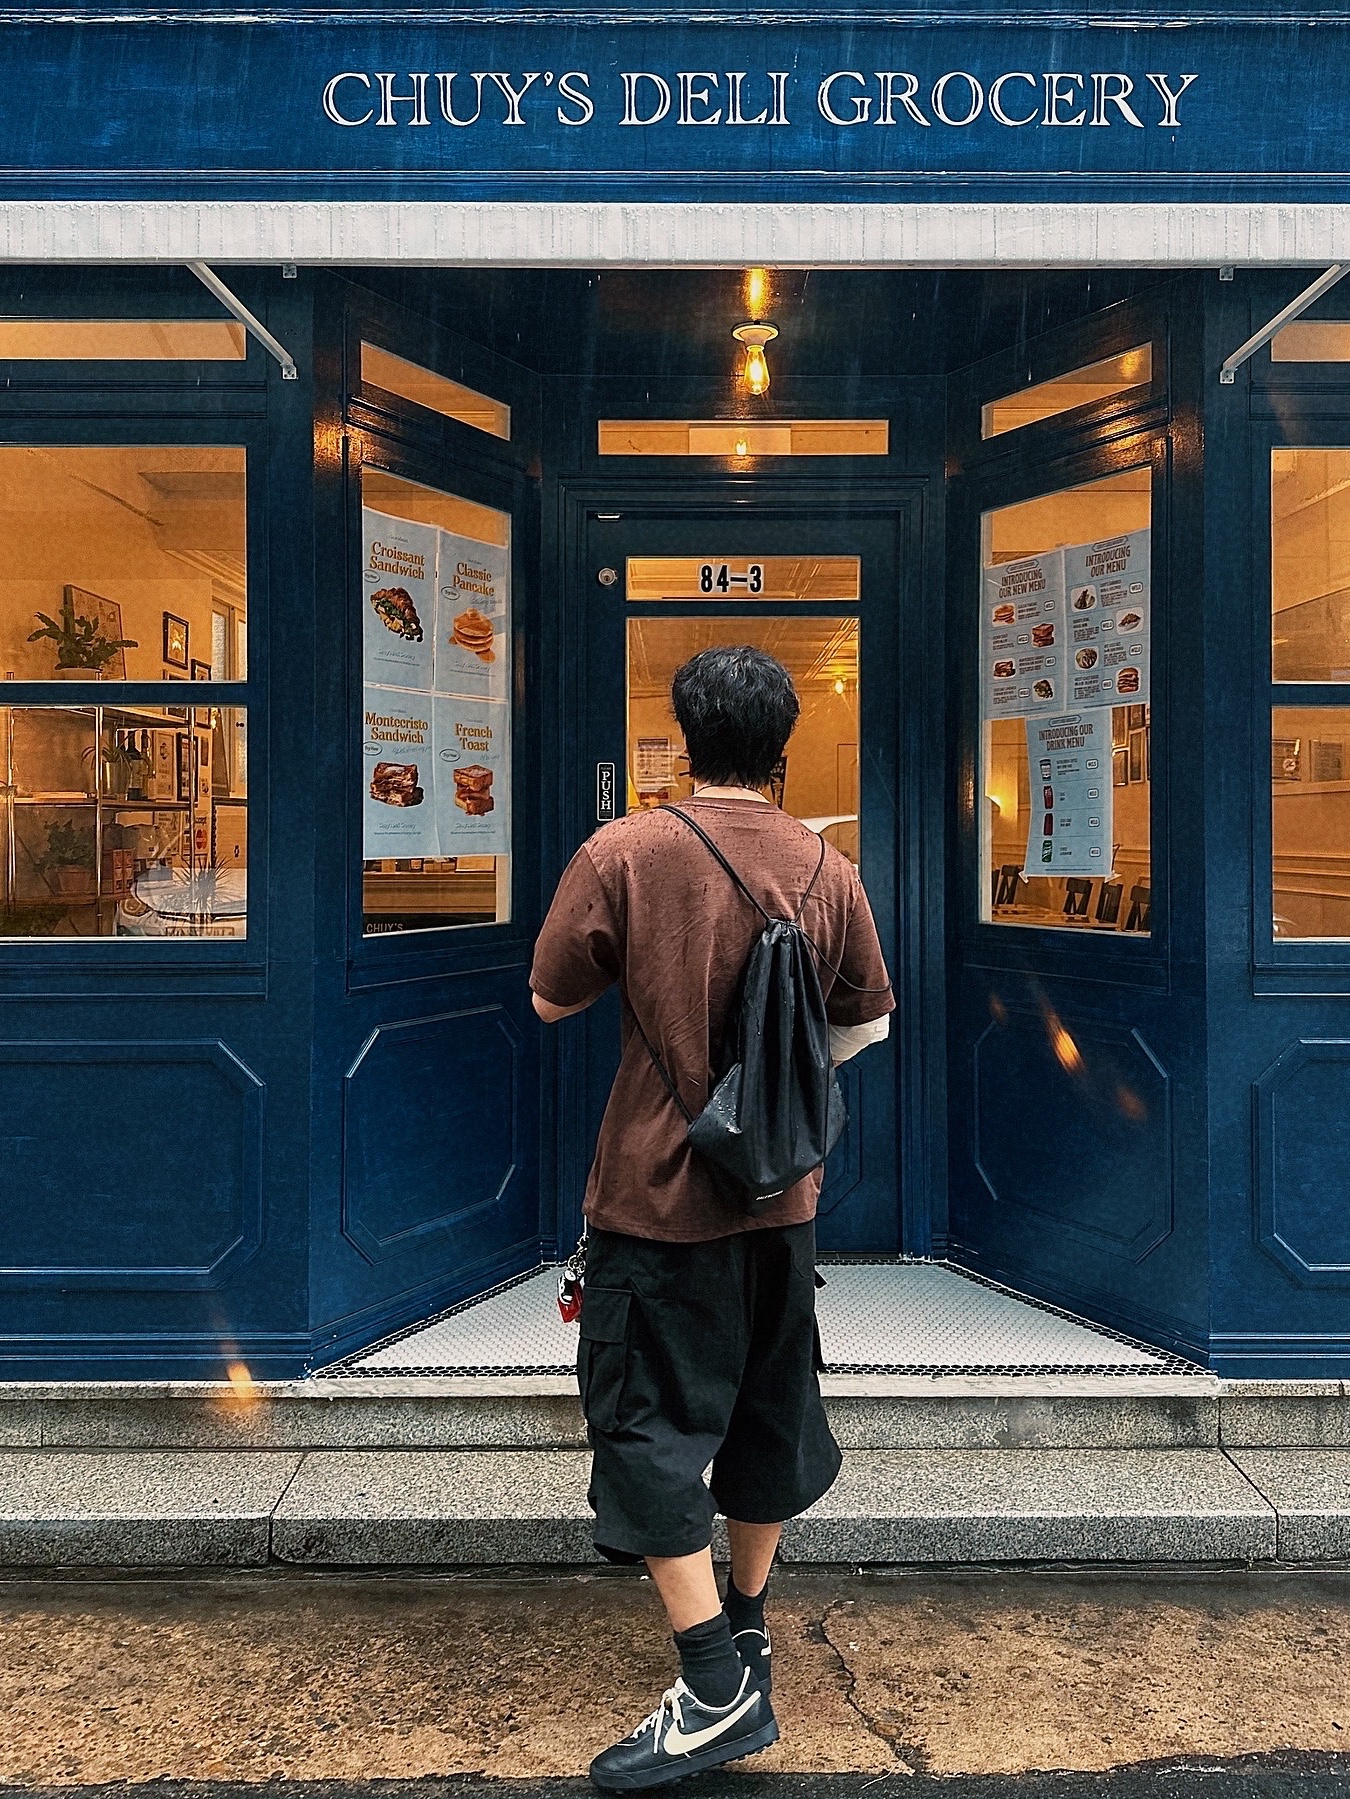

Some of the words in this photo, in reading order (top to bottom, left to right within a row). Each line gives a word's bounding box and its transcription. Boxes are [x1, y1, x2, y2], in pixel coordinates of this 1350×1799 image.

[322, 71, 595, 127] CHUY'S
[618, 71, 791, 127] DELI
[817, 71, 1200, 128] GROCERY
[371, 541, 425, 566] Croissant
[1085, 546, 1131, 568] INTRODUCING
[369, 556, 425, 580] Sandwich
[456, 562, 493, 583] Classic
[1001, 569, 1043, 587] INTRODUCING
[1090, 564, 1106, 578] OUR
[1105, 562, 1127, 575] MENU
[453, 575, 495, 597] Pancake
[701, 565, 762, 592] 84-3
[999, 586, 1013, 599] OUR
[1012, 583, 1028, 596] NEW
[1028, 580, 1046, 592] MENU
[365, 711, 429, 731] Montecristo
[455, 723, 493, 739] French
[371, 729, 424, 744] Sandwich
[1039, 726, 1079, 741] INTRODUCING
[1079, 723, 1094, 735] OUR
[459, 738, 490, 752] Toast
[1046, 739, 1066, 751] DRINK
[1066, 736, 1085, 749] MENU
[600, 771, 611, 810] PUSH
